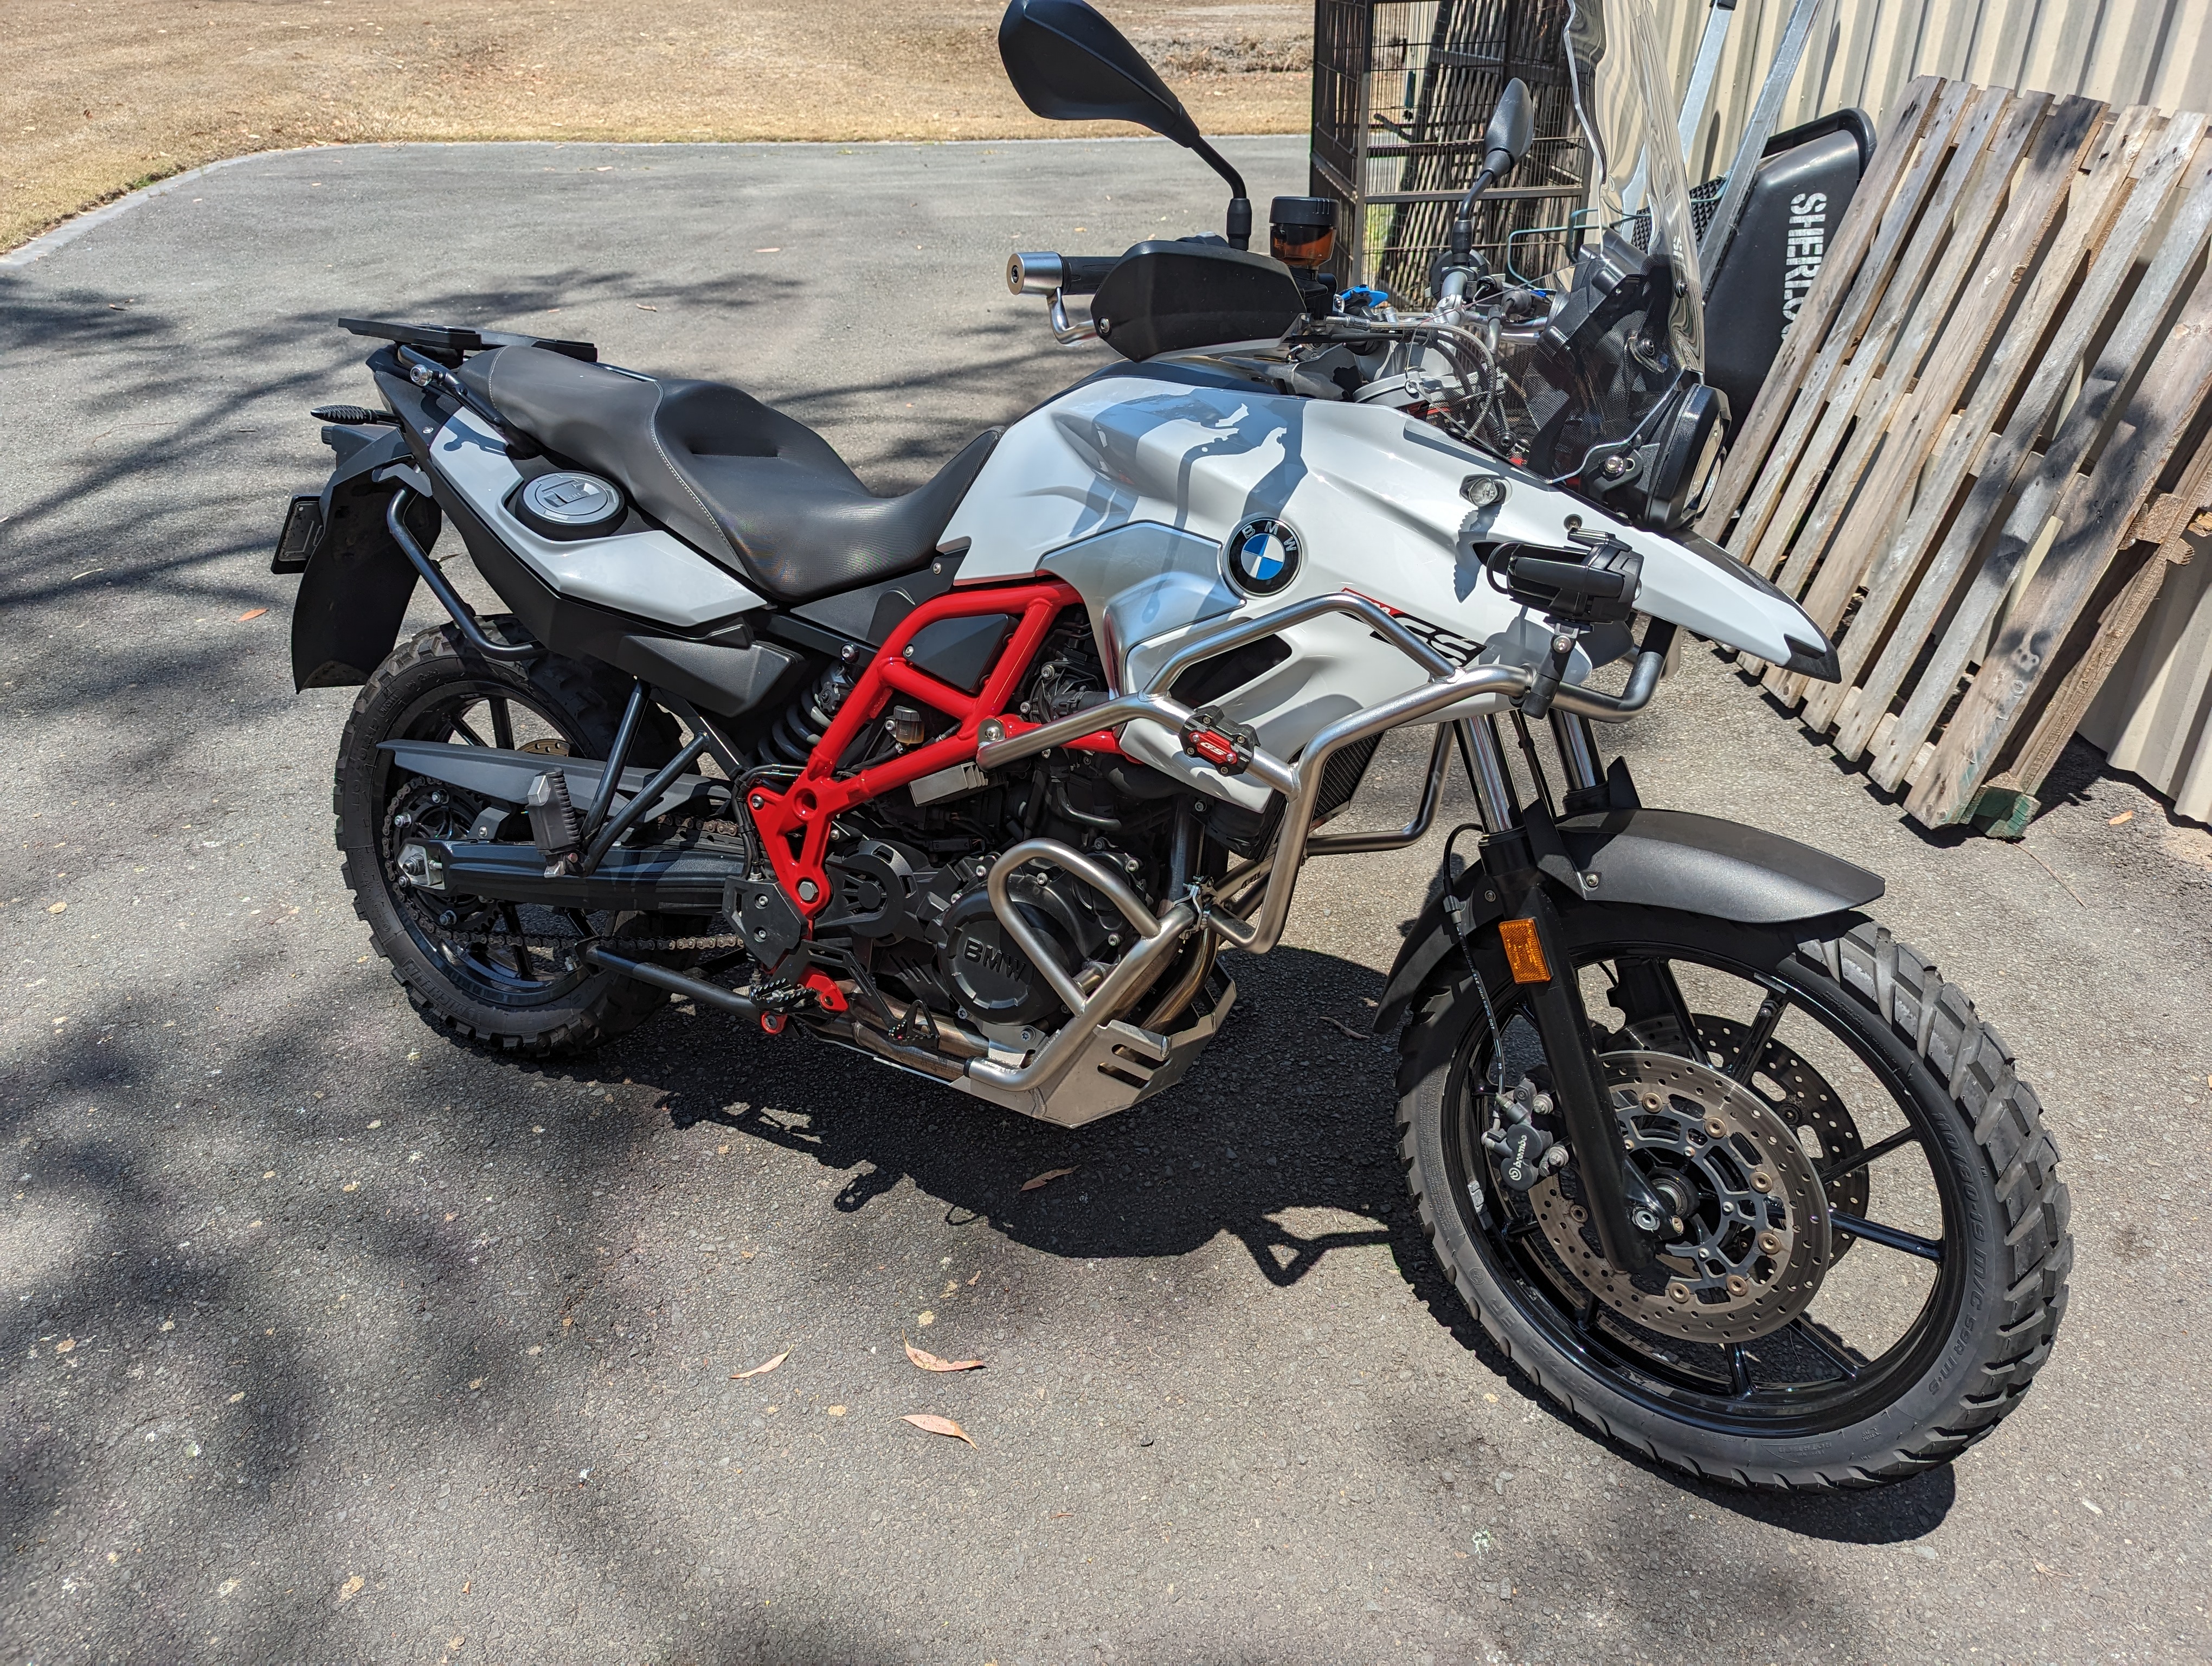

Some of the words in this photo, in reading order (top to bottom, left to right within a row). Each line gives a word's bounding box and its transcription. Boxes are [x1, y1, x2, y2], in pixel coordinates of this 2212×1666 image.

[1780, 192, 1828, 341] SHERLO
[1242, 521, 1297, 552] BMW
[1200, 742, 1227, 755] GS
[964, 937, 1026, 982] BMW
[404, 963, 467, 1015] MICHELIN
[1513, 1135, 1528, 1169] brembo
[1954, 1313, 1976, 1355] 59R
[1489, 1297, 1621, 1416] METZELER
